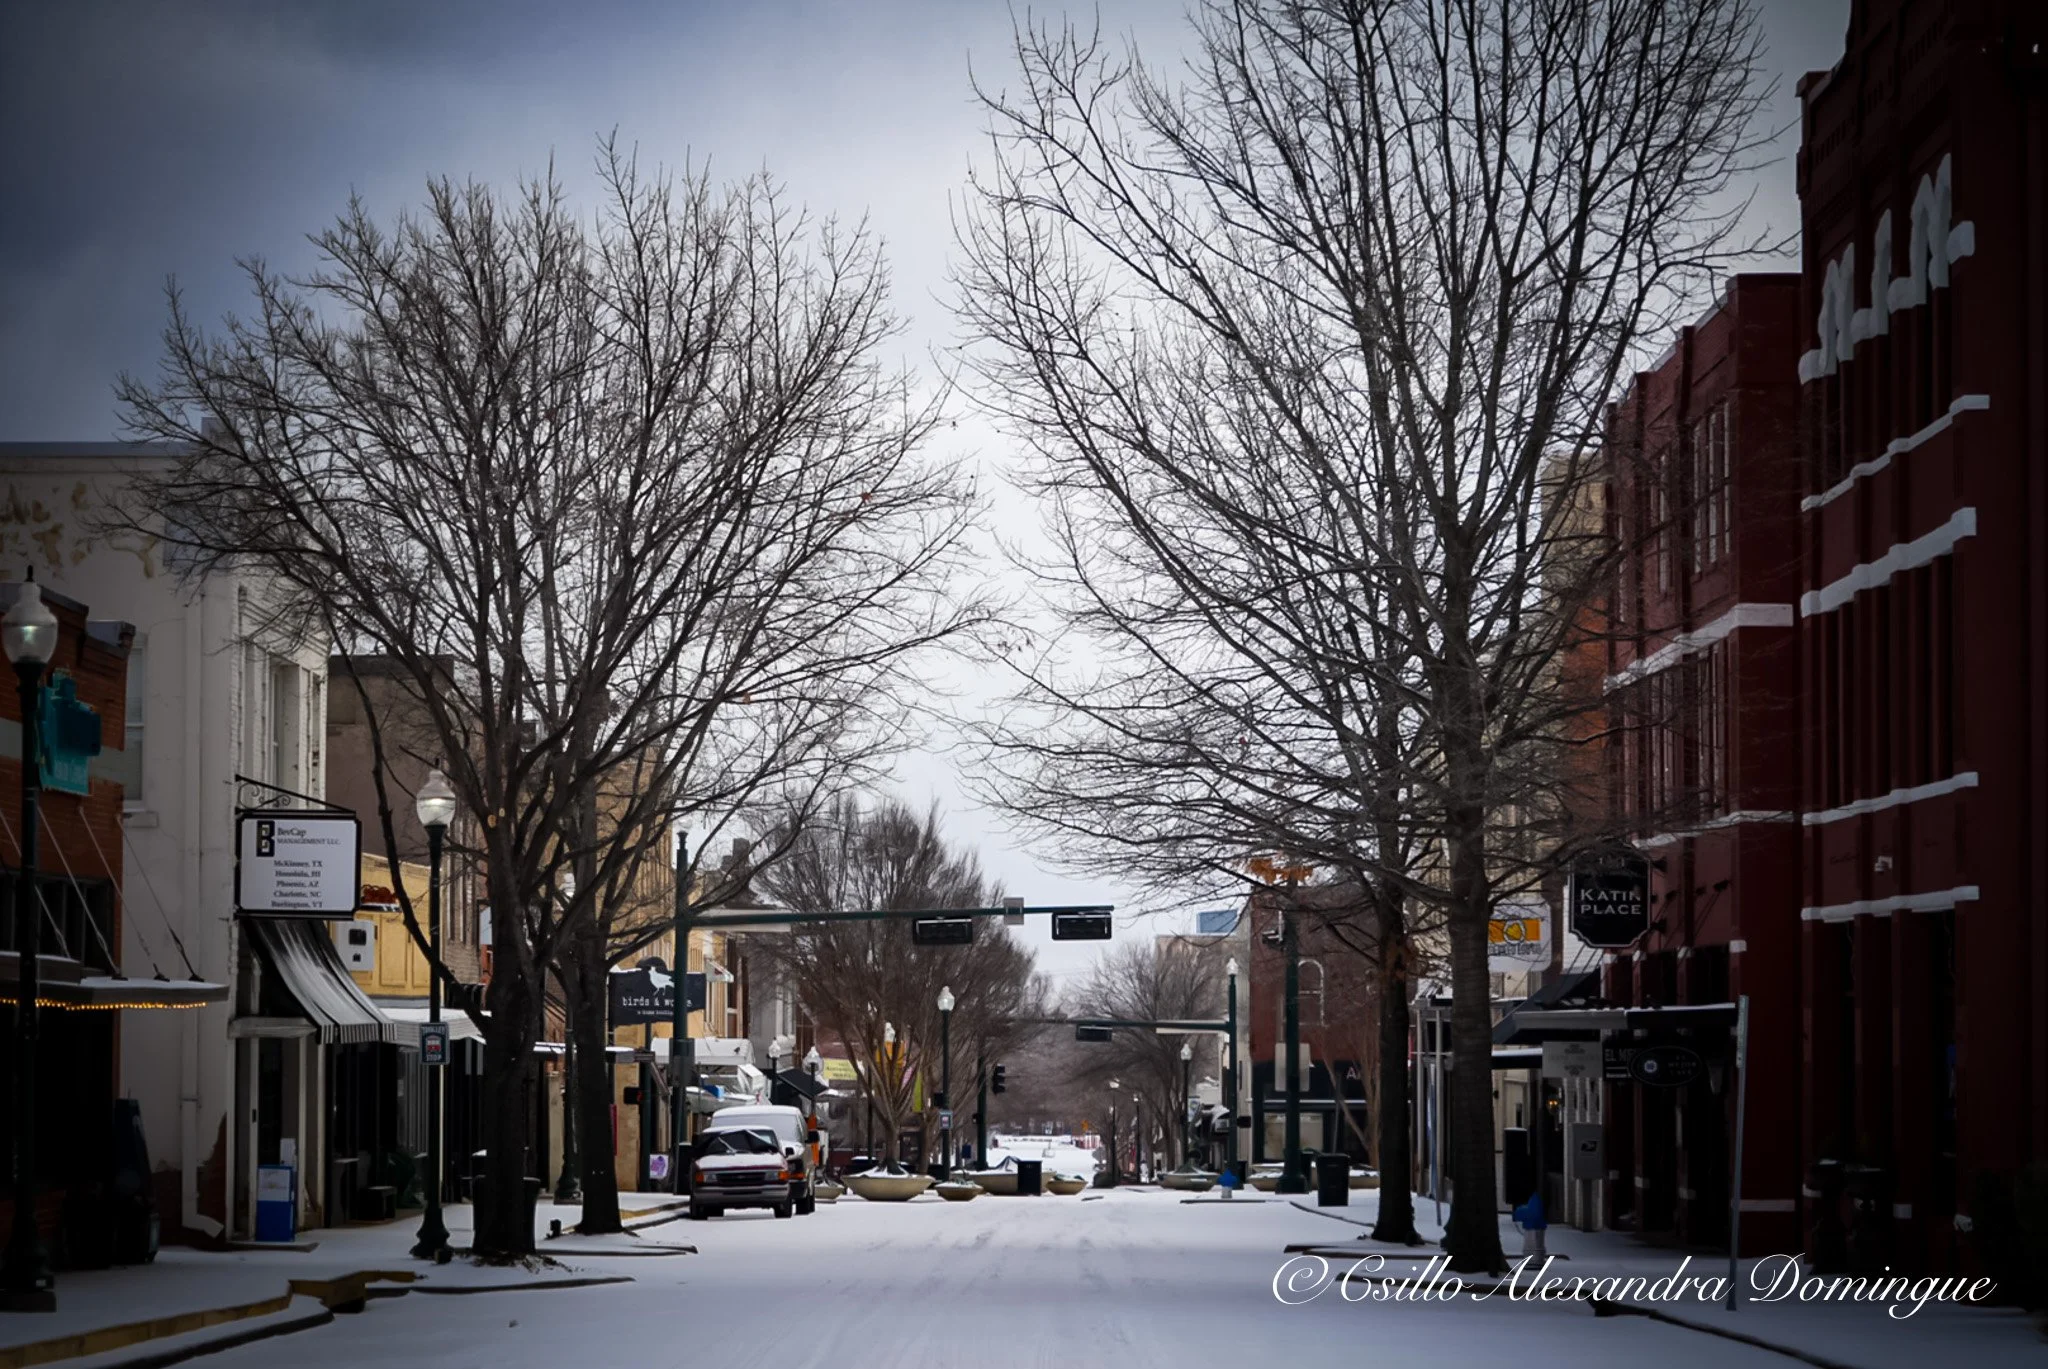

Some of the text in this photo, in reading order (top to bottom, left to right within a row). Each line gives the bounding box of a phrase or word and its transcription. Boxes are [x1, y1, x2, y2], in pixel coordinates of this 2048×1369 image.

[312, 860, 323, 868] TX
[311, 870, 321, 878] HI
[1580, 904, 1643, 915] PLACE
[622, 995, 650, 1007] birds
[653, 996, 660, 1007] &
